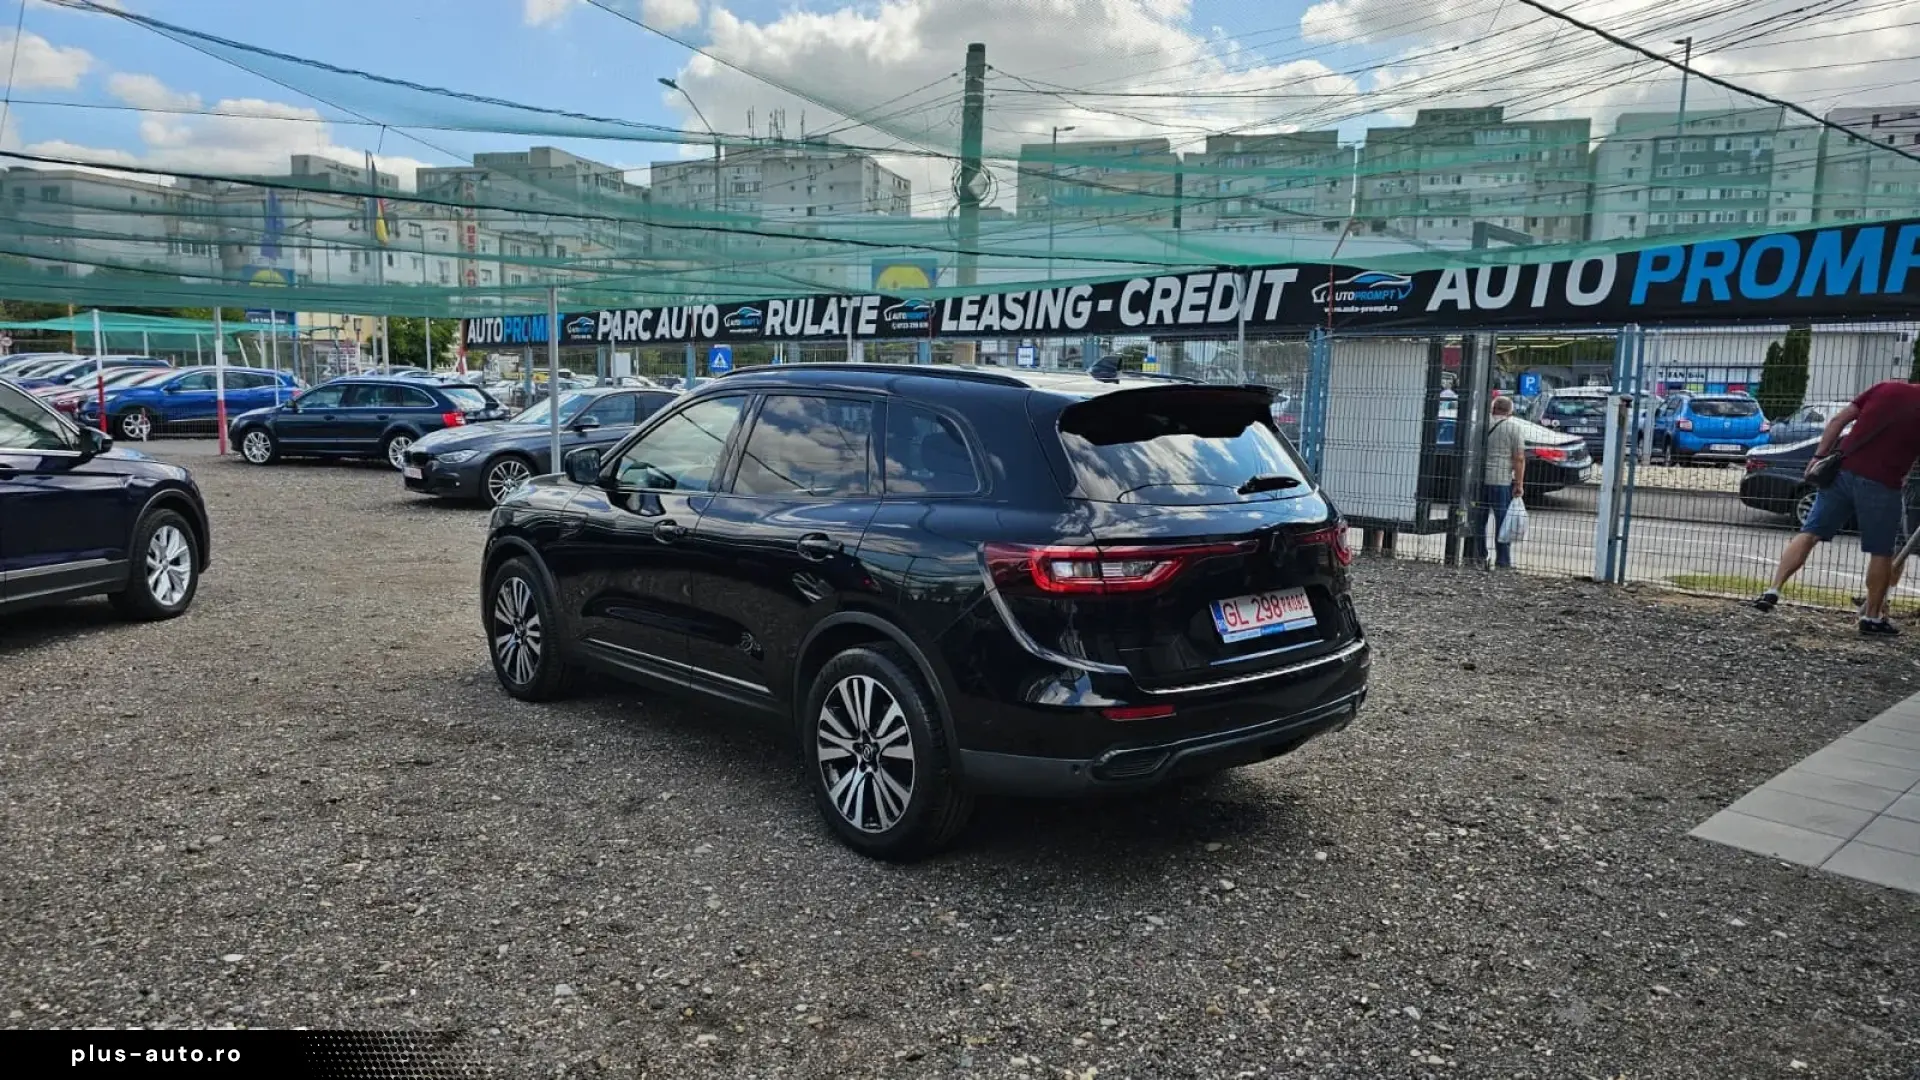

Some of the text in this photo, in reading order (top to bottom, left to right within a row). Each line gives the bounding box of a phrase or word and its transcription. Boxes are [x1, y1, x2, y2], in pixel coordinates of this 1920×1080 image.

[1425, 250, 1618, 311] AUTO
[598, 304, 719, 341] PARC AUTO
[765, 296, 880, 335] RULATE
[1526, 377, 1535, 389] P
[1223, 600, 1249, 627] GL
[1251, 594, 1283, 622] 298
